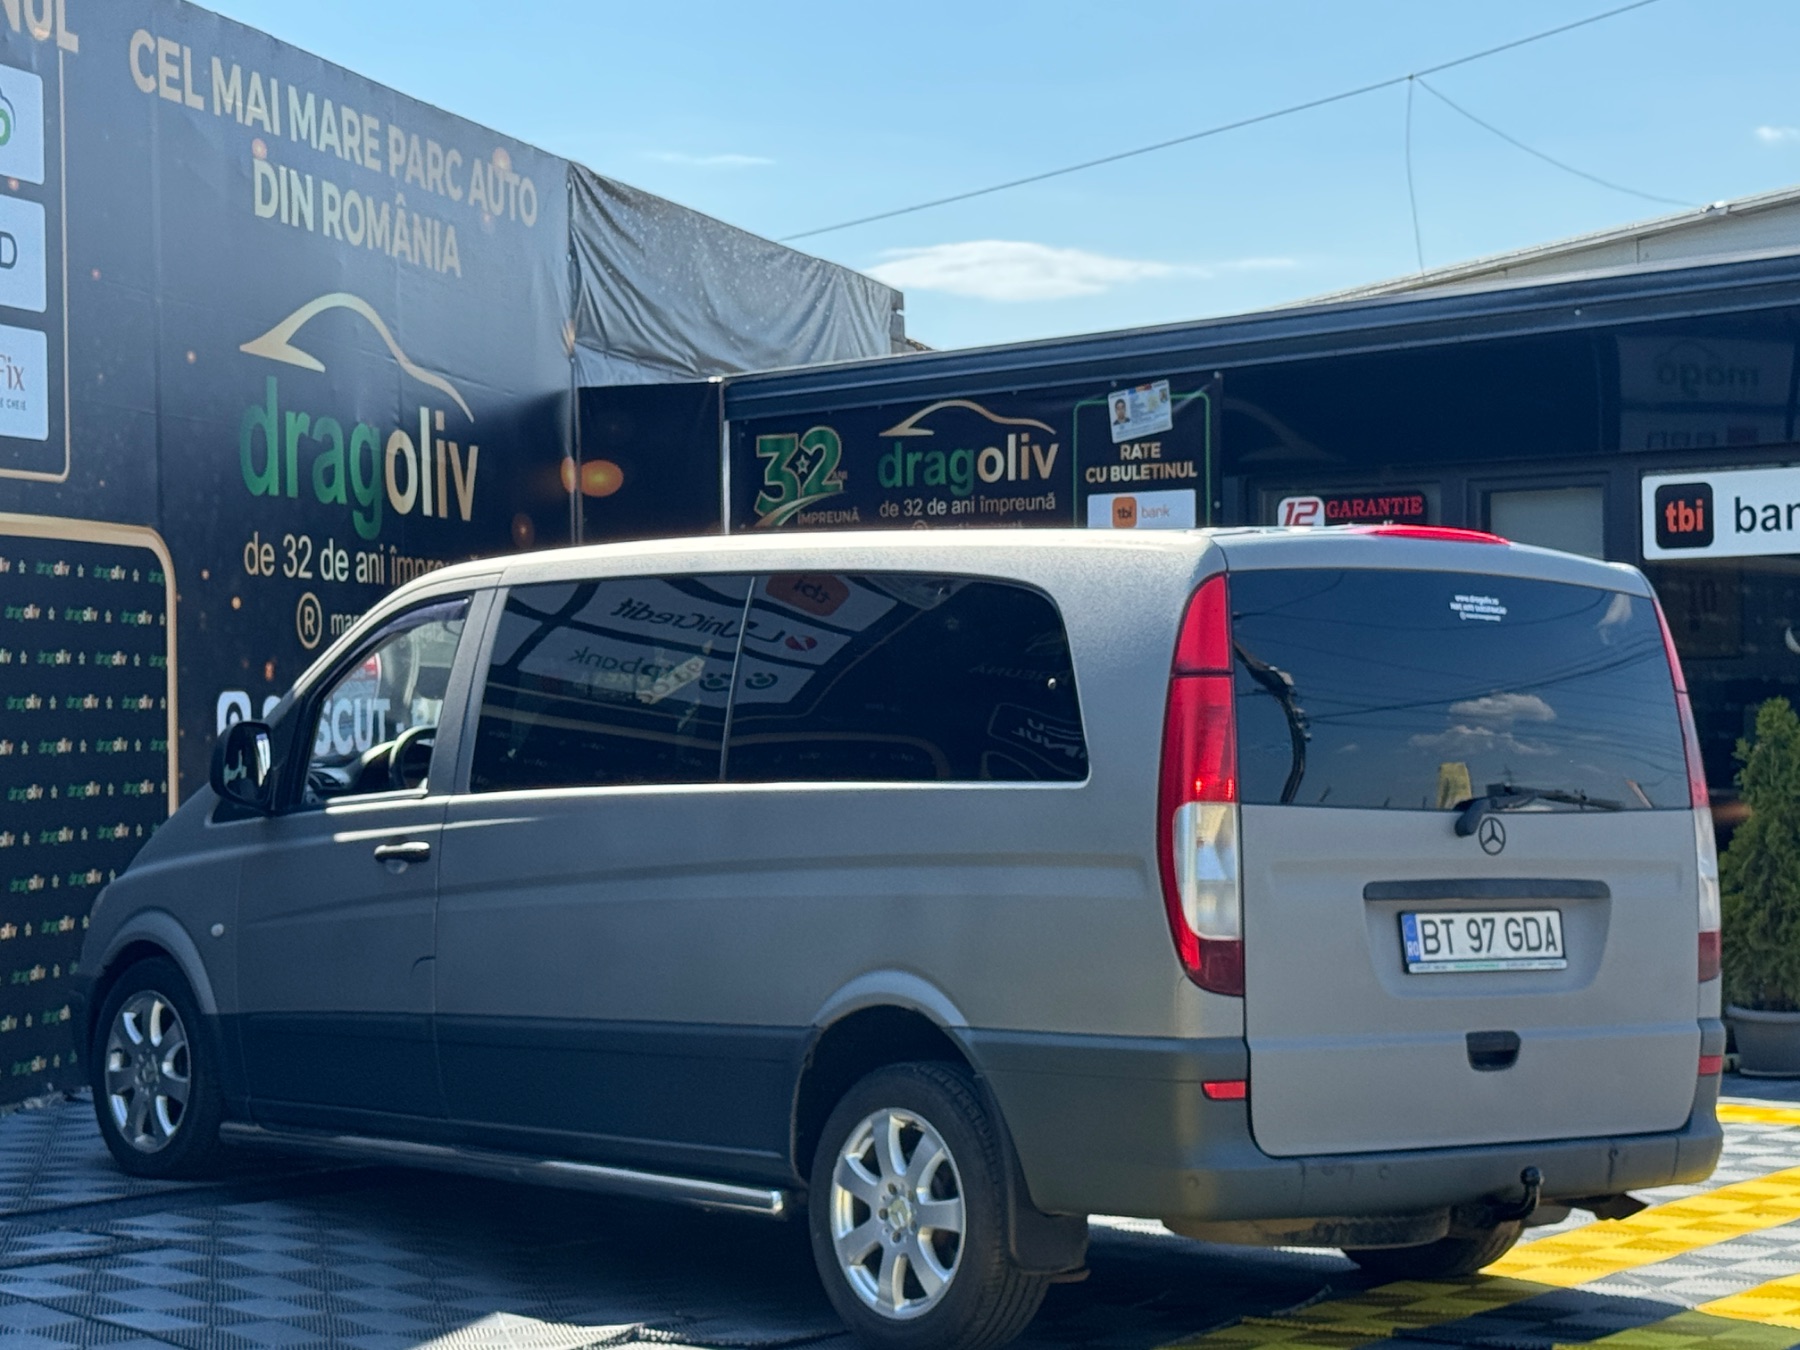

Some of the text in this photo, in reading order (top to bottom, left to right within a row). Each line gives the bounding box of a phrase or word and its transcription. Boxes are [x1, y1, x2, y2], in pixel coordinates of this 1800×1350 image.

[129, 28, 538, 228] CEL MAI MARE PARC AUTO
[253, 157, 463, 279] DIN ROMÂNIA
[239, 375, 479, 541] dragoliv
[877, 432, 1060, 496] dragoliv
[1120, 442, 1162, 460] RATE
[1085, 461, 1198, 483] CU BULETINUL
[879, 493, 1056, 518] de 32 de ani împreună
[1117, 507, 1170, 519] tbi bank
[1284, 496, 1423, 526] 12 GARANTIE
[1665, 499, 1705, 533] tbi
[243, 531, 275, 577] de
[282, 534, 313, 579] 32
[320, 538, 349, 582] de
[356, 544, 384, 585] ani
[1407, 941, 1420, 957] RO
[1420, 915, 1558, 955] BT 97 GDA
